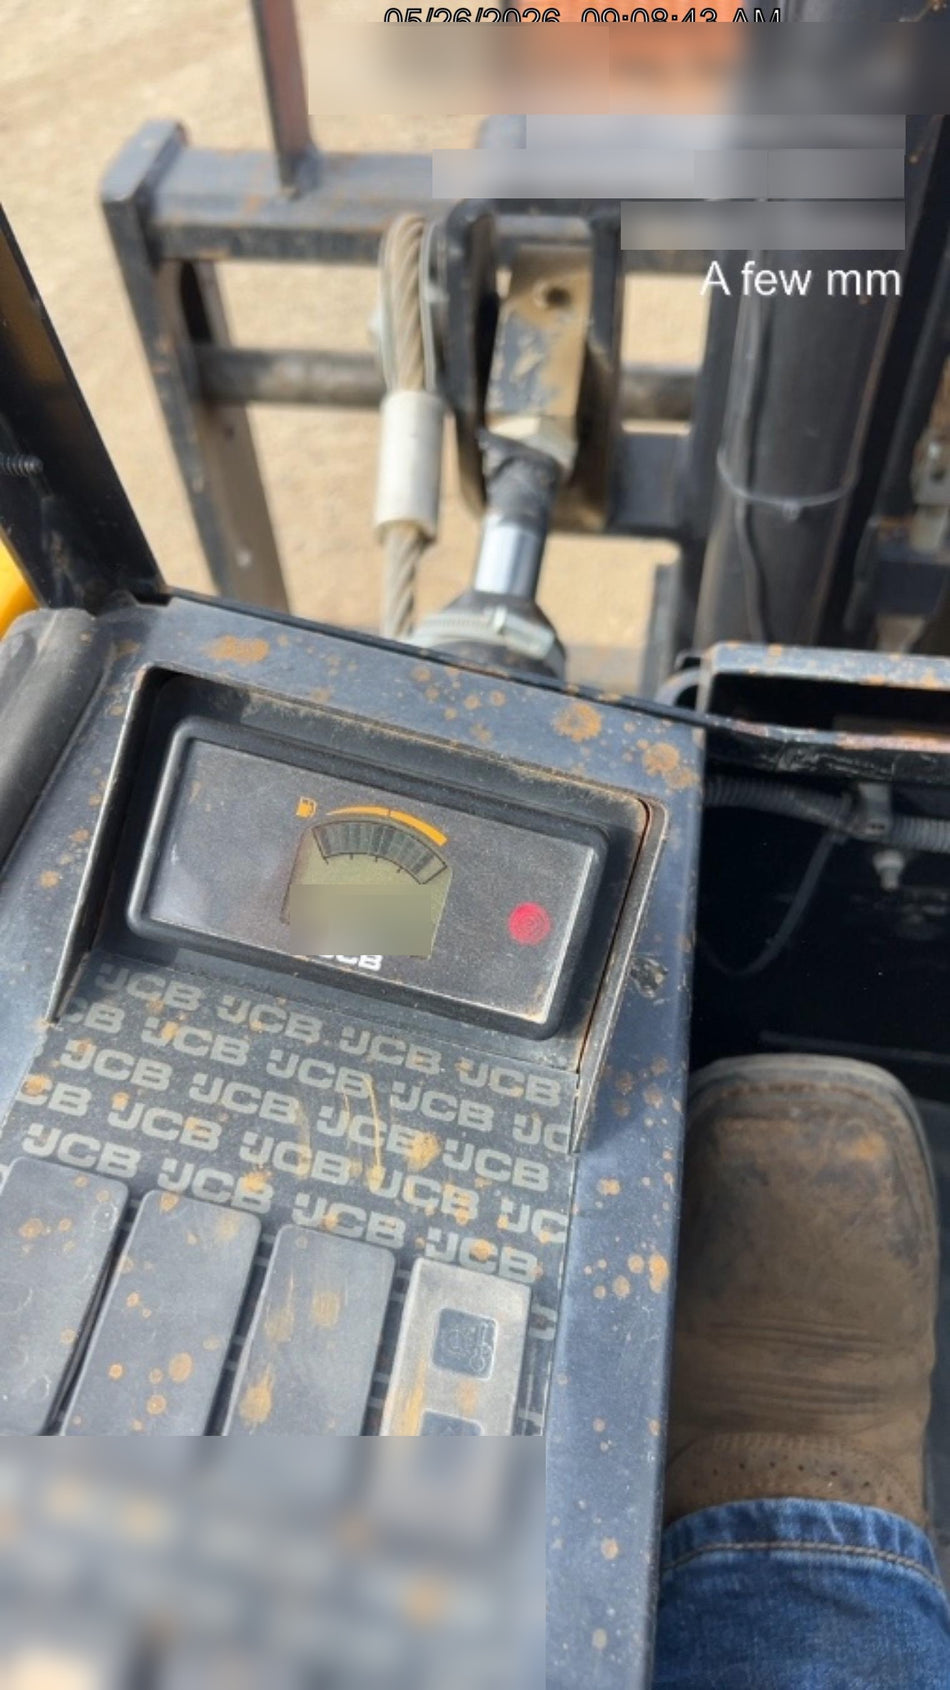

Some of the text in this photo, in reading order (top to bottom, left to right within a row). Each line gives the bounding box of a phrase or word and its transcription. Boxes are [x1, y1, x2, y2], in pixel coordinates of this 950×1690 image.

[62, 997, 571, 1154] CB JCB JCB JCB JC
[95, 963, 561, 1107] JCB JCB JCB JCB
[16, 1076, 569, 1243] CB JCB JCB JCB JC
[60, 1038, 549, 1192] JCB JCB JCB JCB
[22, 1122, 538, 1283] JCB JCB JCB JCB
